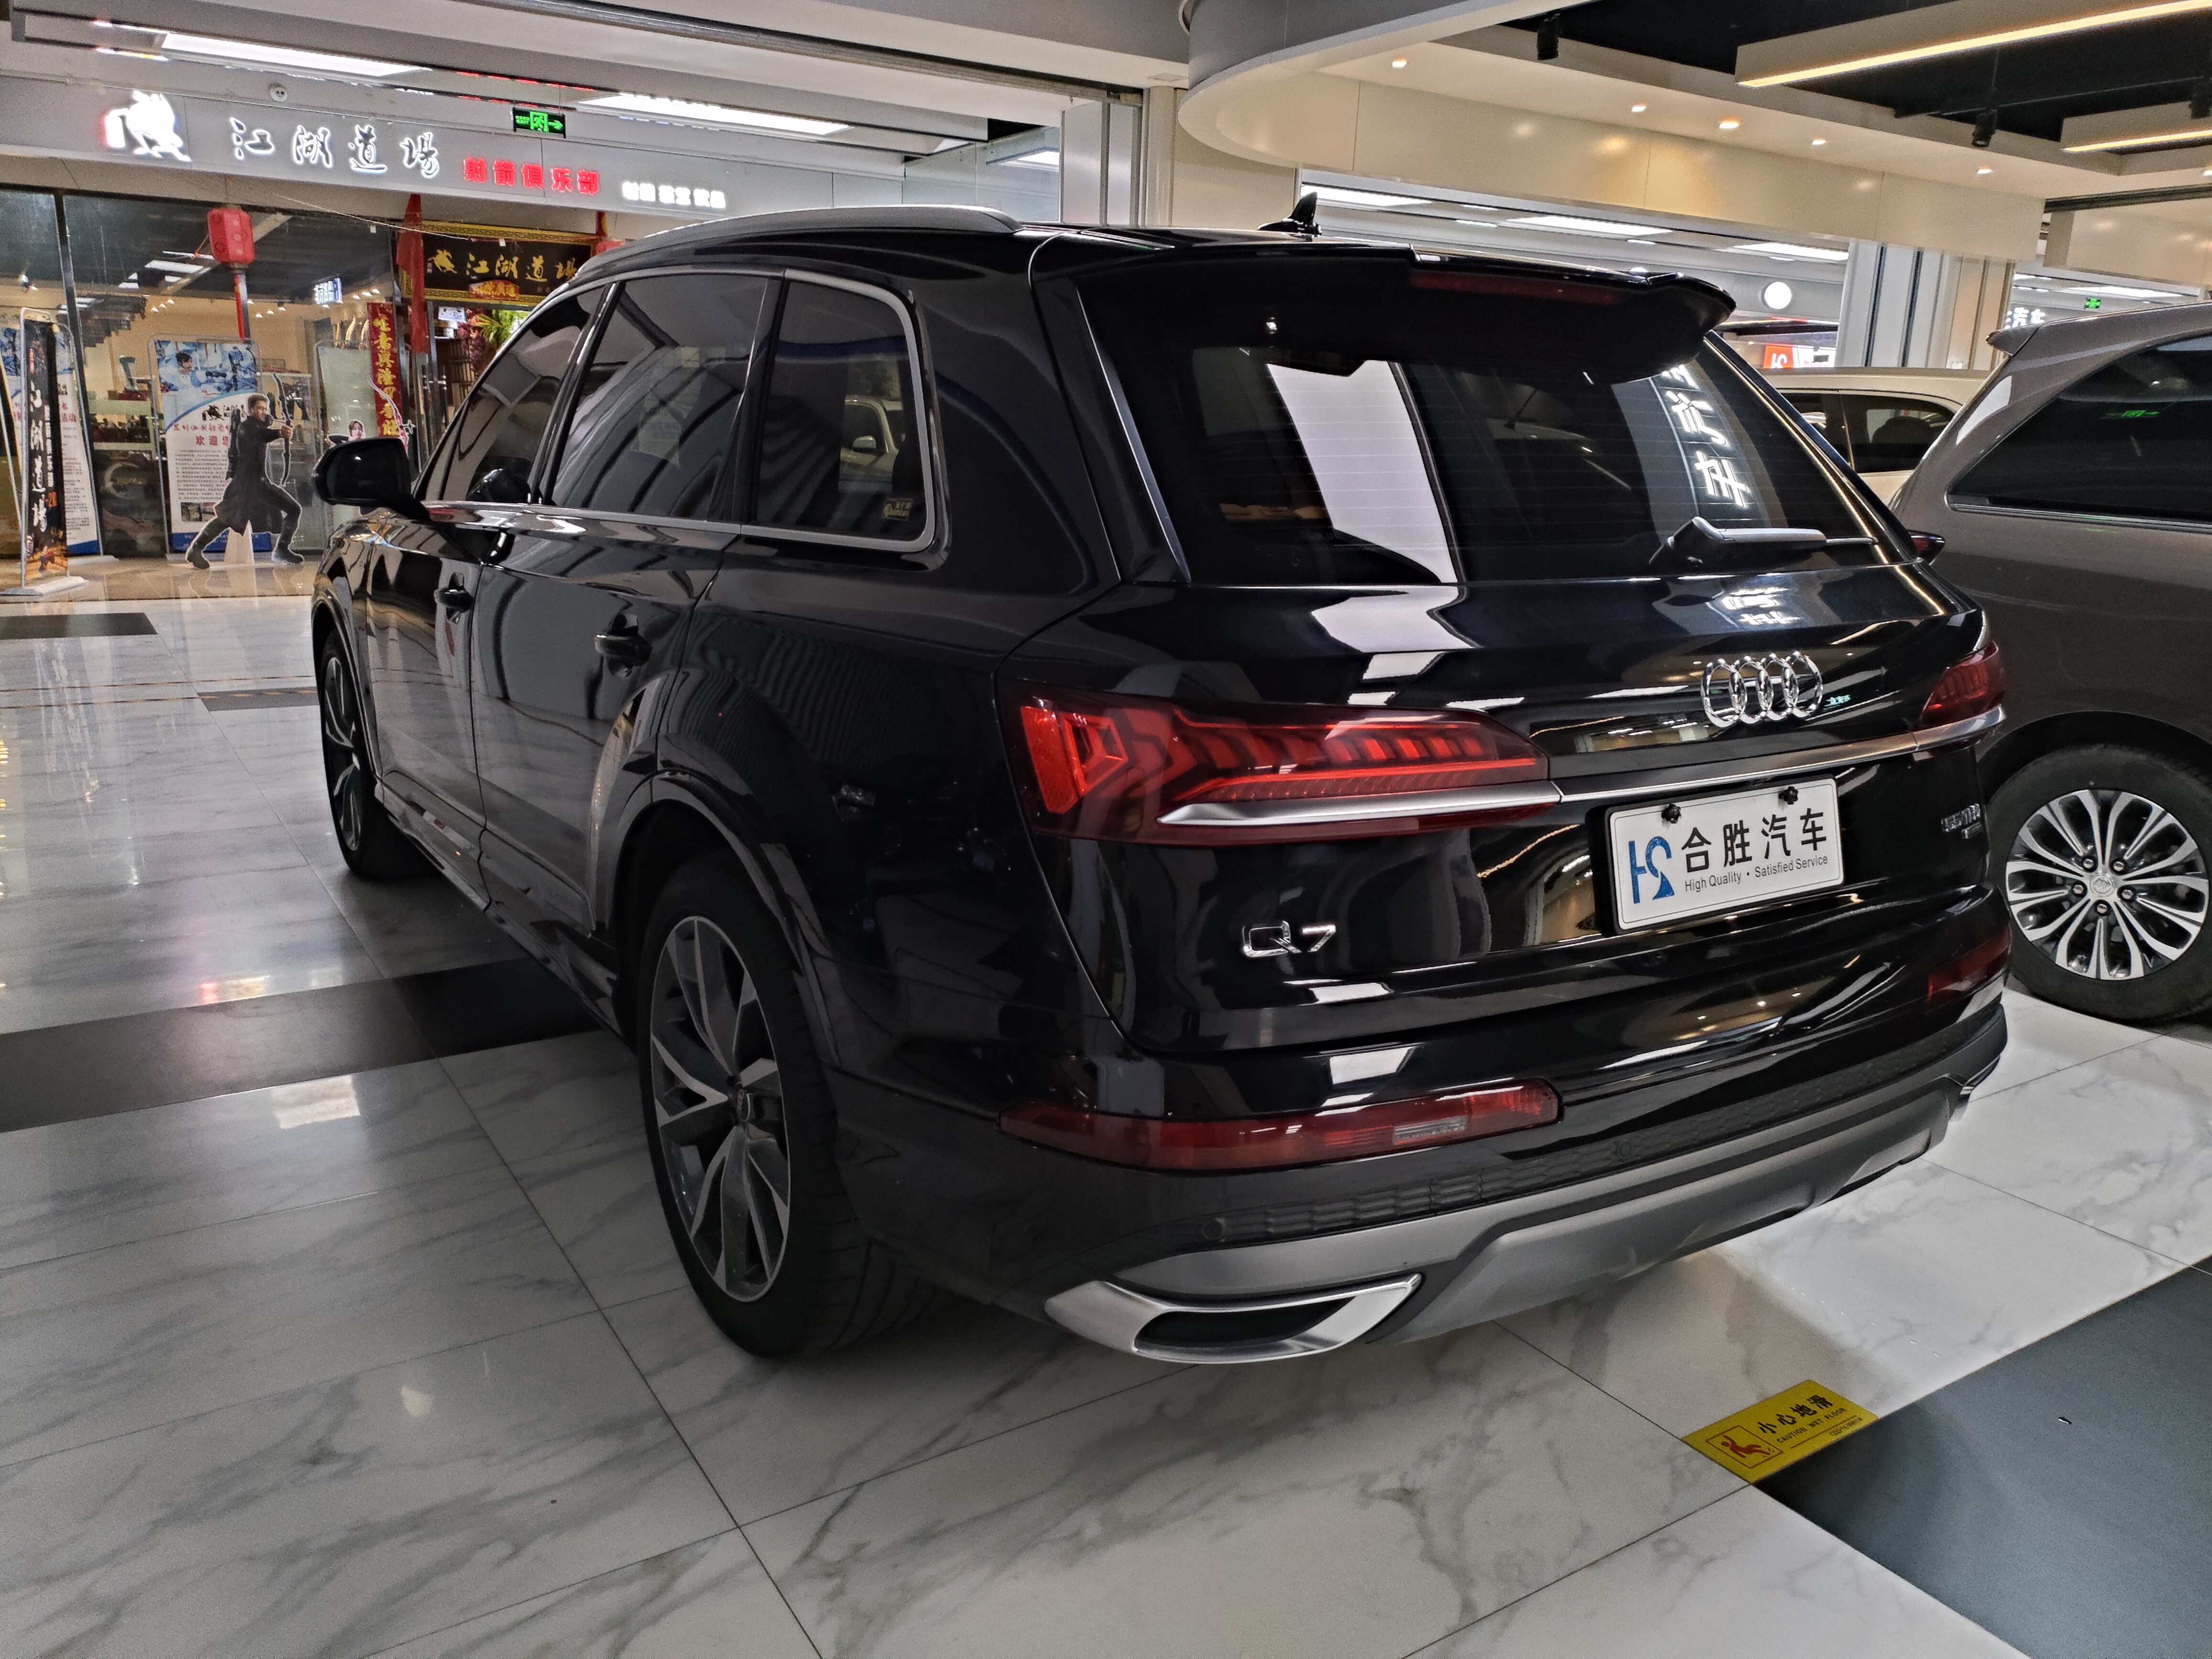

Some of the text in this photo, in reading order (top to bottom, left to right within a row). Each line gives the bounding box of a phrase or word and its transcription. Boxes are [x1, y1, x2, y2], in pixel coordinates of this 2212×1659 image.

[463, 157, 599, 195] 射箭俱乐部
[1681, 807, 1827, 873] 合胜汽车
[1685, 855, 1828, 893] High Quality Satisfied Service
[1242, 920, 1337, 957] Q7
[1758, 1394, 1834, 1435] 小心地滑
[1776, 1427, 1808, 1444] CAUTION
[1808, 1418, 1824, 1428] WET
[1824, 1407, 1847, 1420] FLOOR
